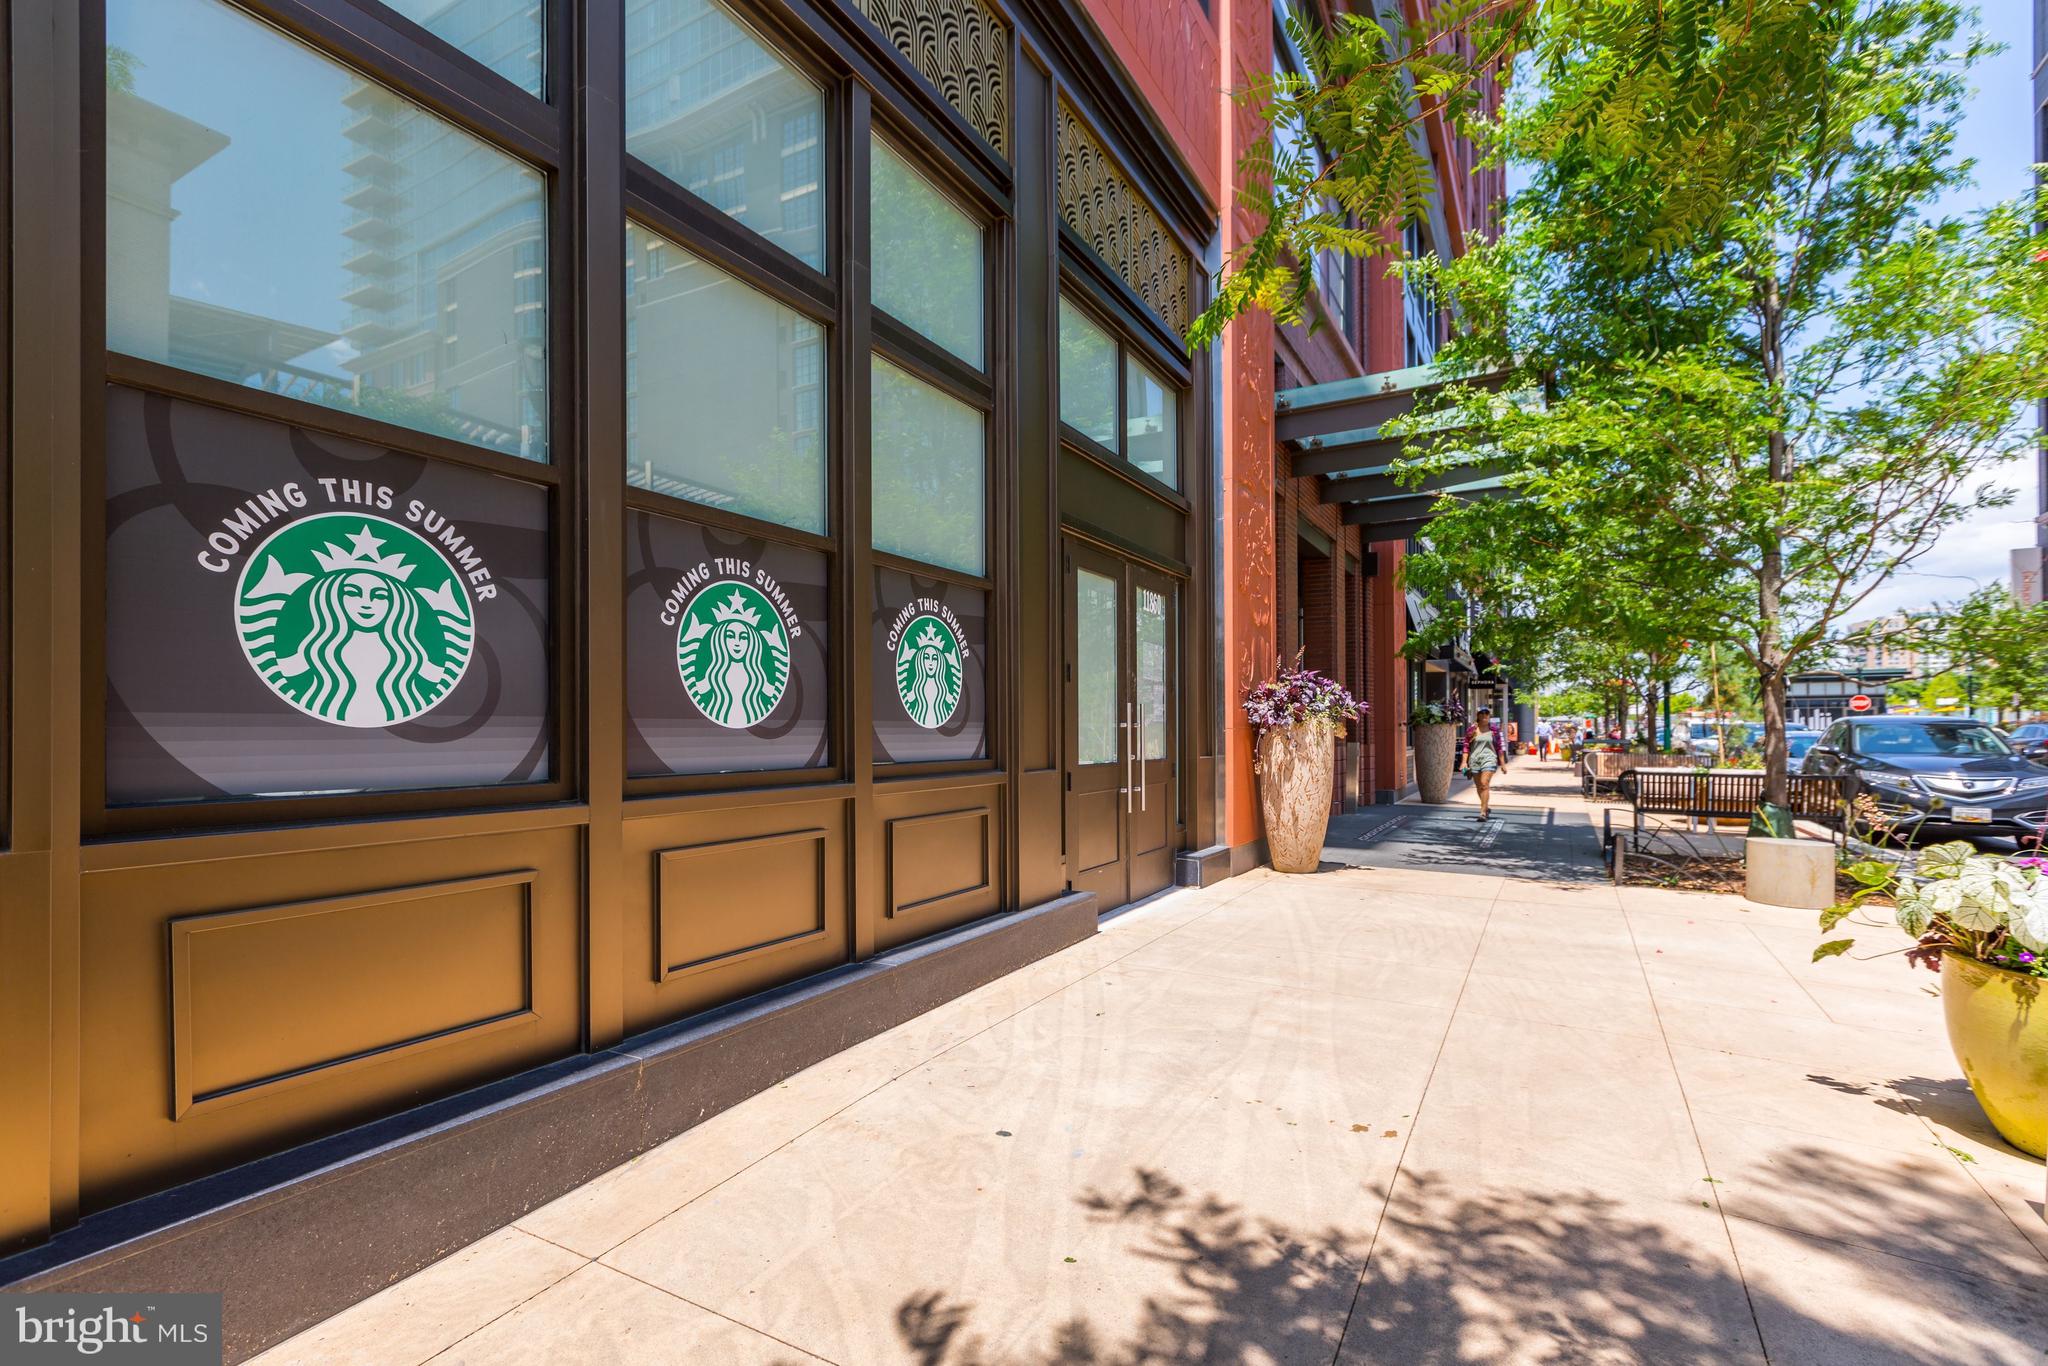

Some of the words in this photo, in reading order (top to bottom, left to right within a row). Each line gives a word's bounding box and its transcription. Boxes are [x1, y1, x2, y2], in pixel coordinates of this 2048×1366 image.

[197, 481, 308, 573] COMING
[317, 477, 394, 510] THIS
[405, 500, 498, 603] SUMMER
[660, 563, 710, 627] COMING
[714, 557, 751, 578] THIS
[755, 569, 801, 640] SUMMER
[886, 602, 916, 652] COMING
[917, 597, 939, 612] THIS
[941, 605, 970, 659] SUMMER
